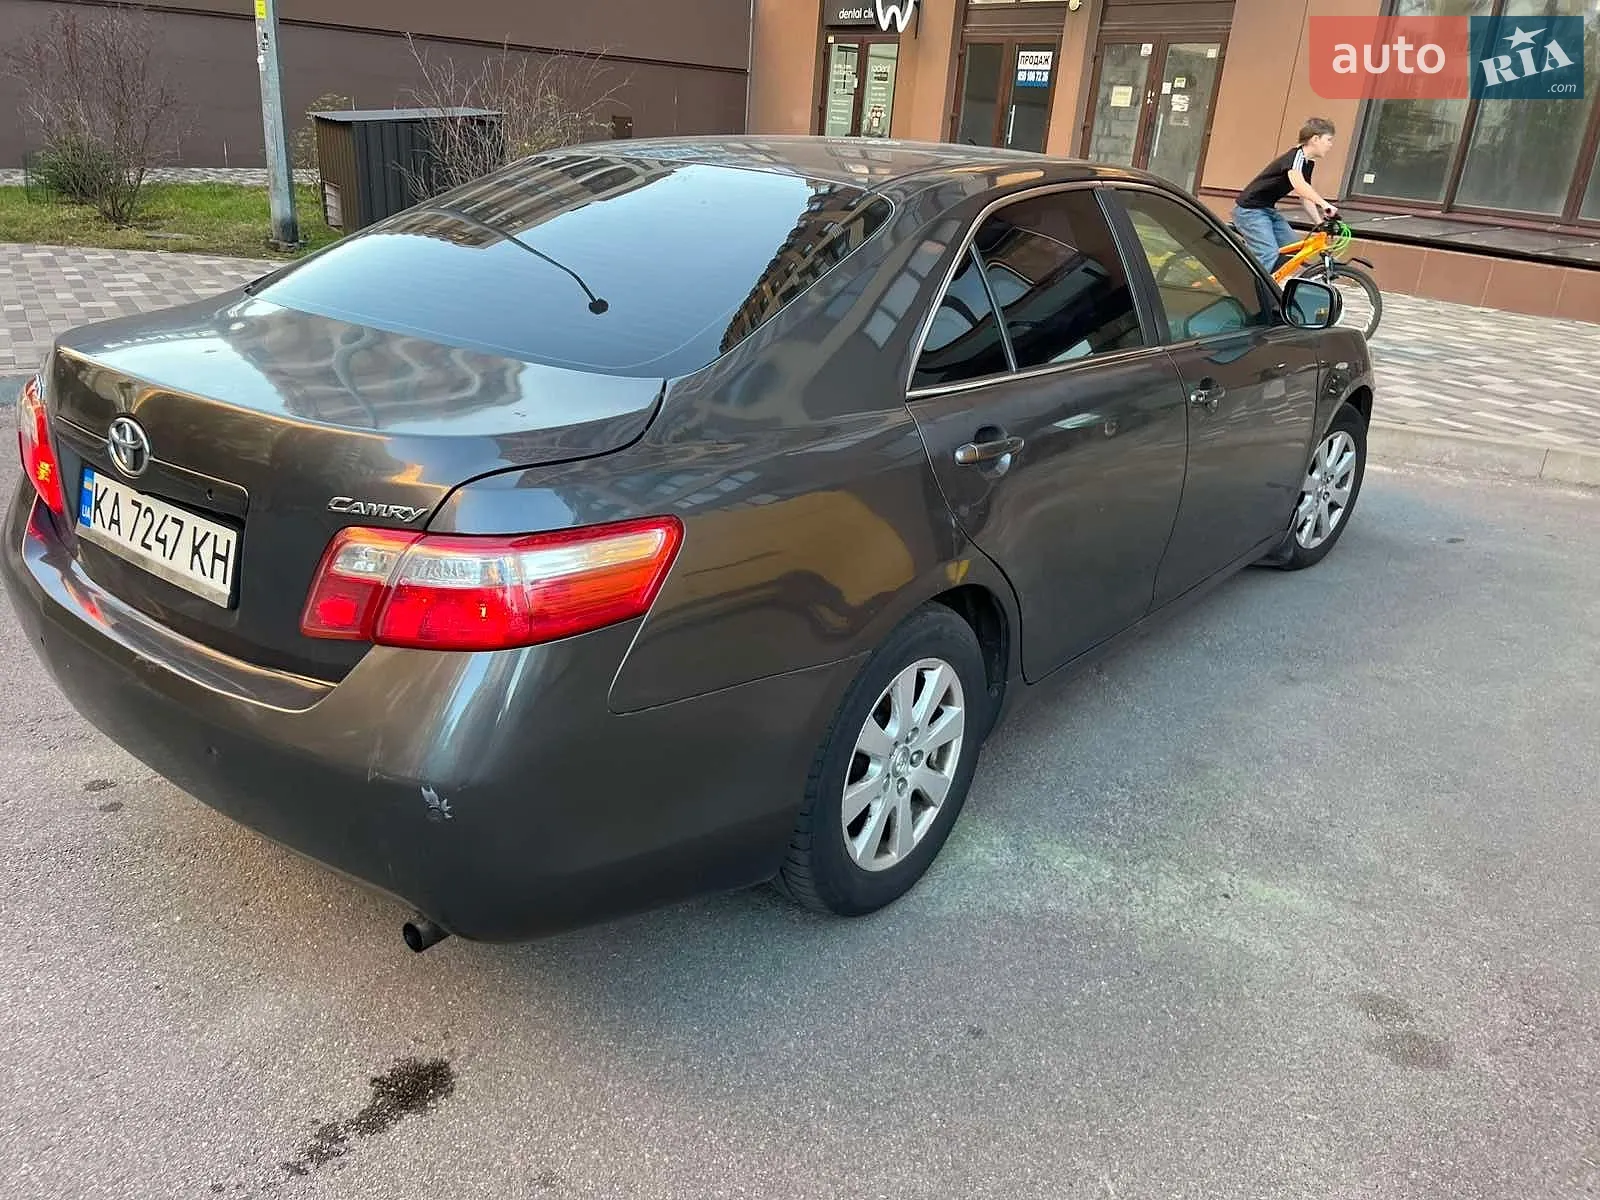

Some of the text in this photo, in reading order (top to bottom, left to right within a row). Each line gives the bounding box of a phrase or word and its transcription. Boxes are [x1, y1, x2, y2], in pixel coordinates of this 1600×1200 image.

[838, 7, 863, 19] dental
[1020, 55, 1050, 65] ПРОДАЖ
[81, 504, 91, 519] UA
[328, 496, 429, 523] CAMRY
[93, 482, 231, 585] KA 7247 KH
